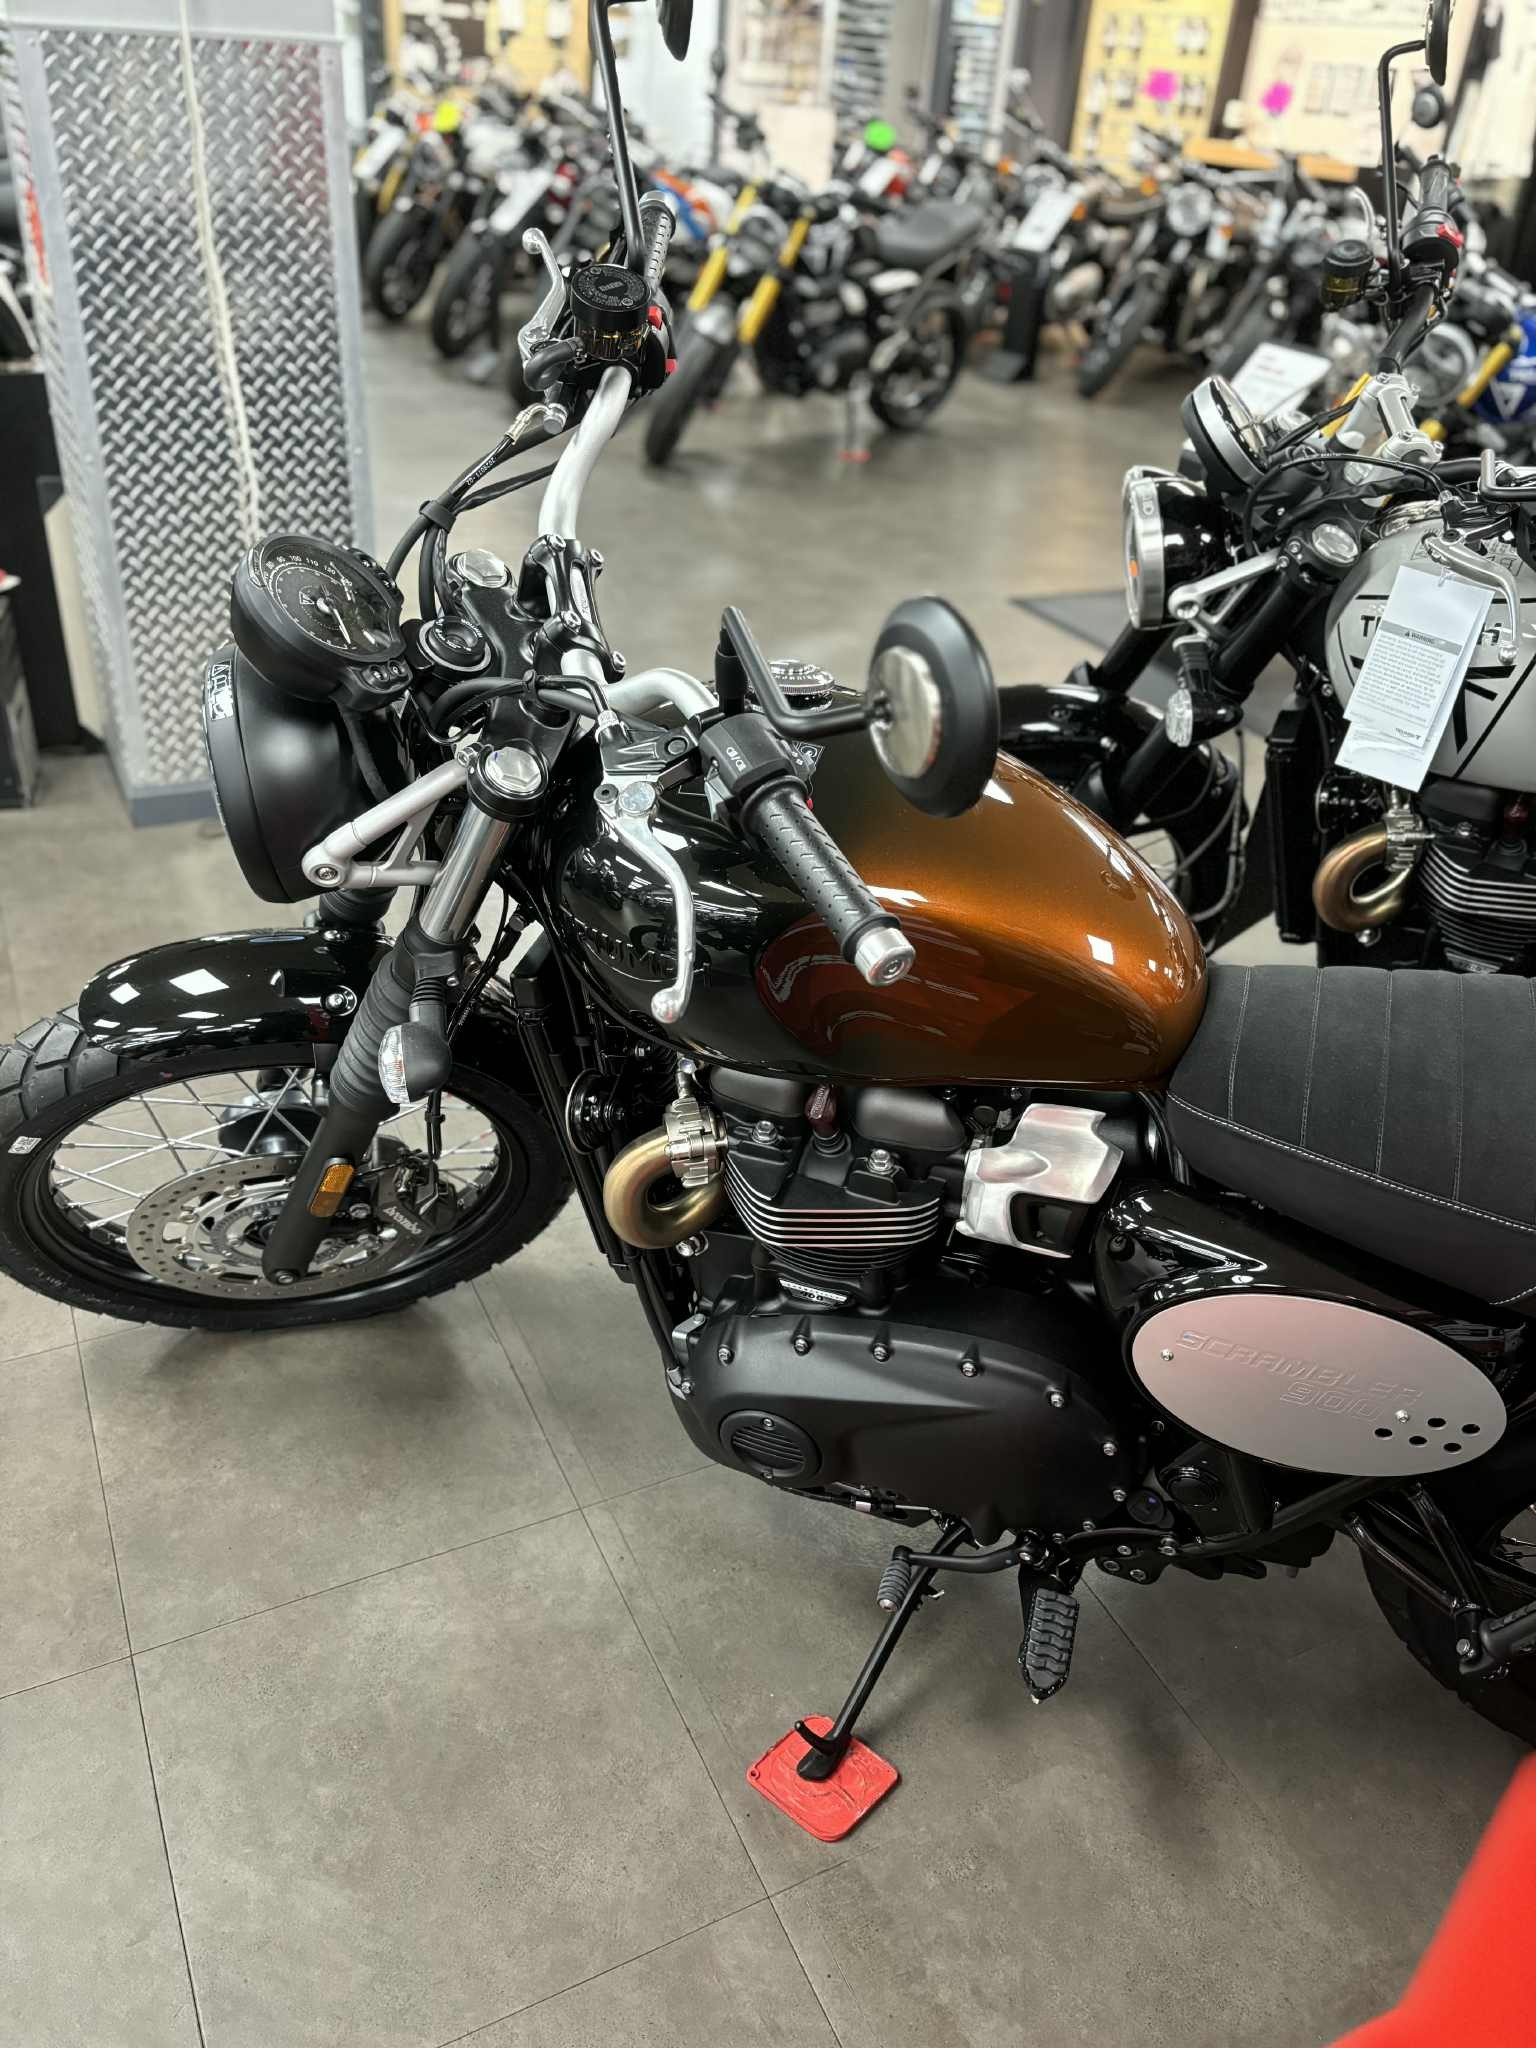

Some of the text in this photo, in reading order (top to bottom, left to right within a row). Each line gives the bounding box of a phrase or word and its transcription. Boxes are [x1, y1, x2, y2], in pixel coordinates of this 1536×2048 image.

[305, 557, 319, 567] 110
[383, 1205, 423, 1235] brembo
[1176, 1329, 1424, 1406] SCRAMBLER
[1279, 1381, 1386, 1423] 900
